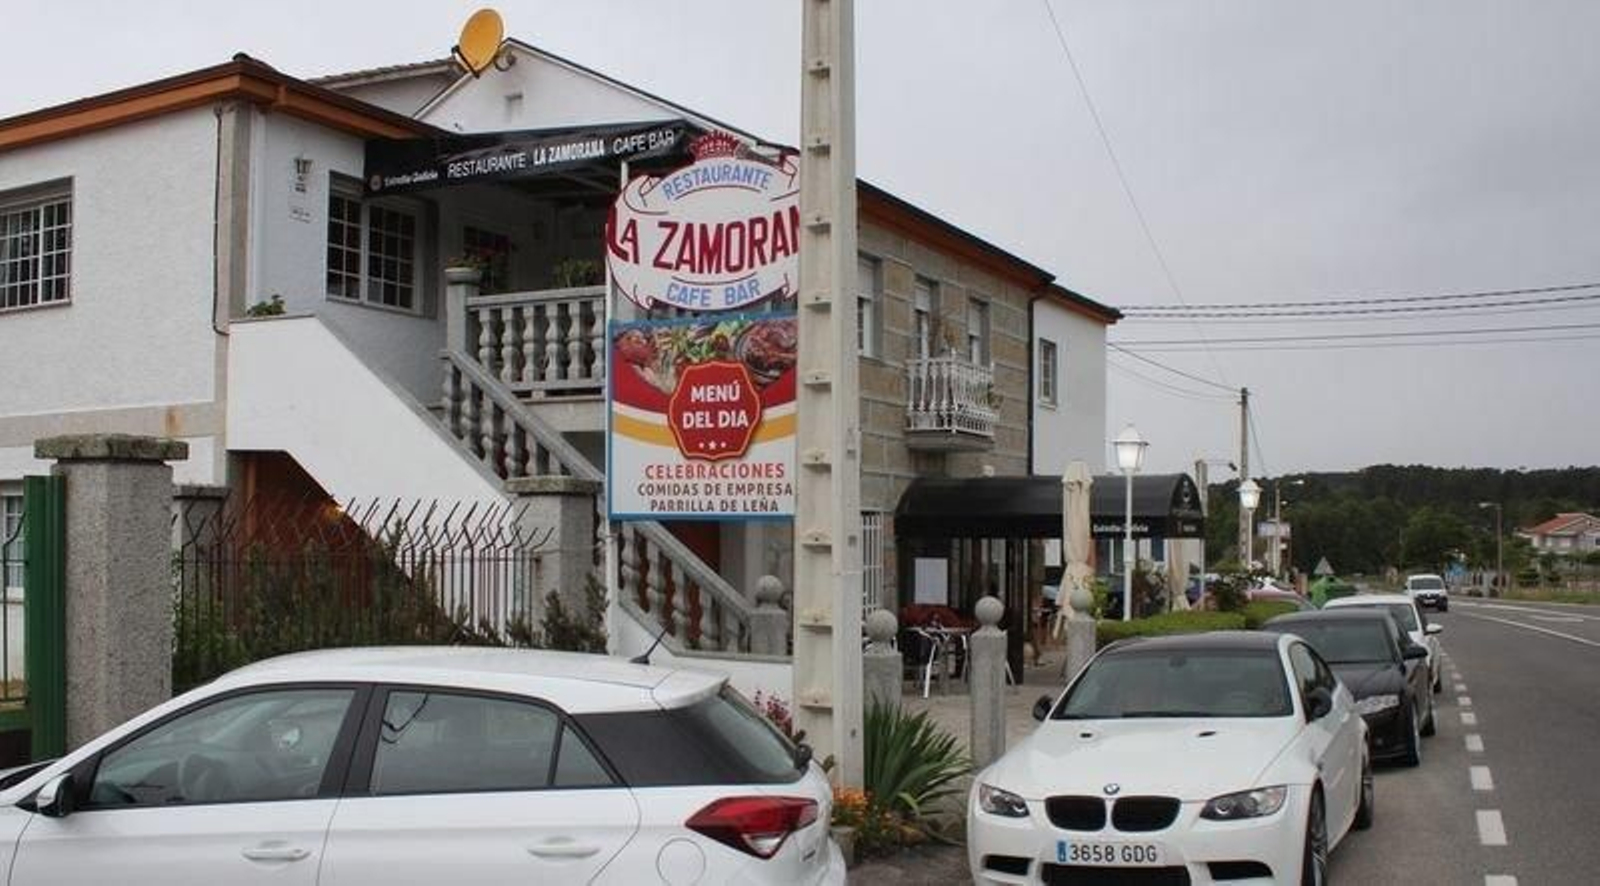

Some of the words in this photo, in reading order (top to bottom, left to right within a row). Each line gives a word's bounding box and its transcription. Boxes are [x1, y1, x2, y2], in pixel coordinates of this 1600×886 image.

[533, 148, 546, 166] LA
[549, 139, 605, 162] ZAMORANA
[613, 134, 646, 154] CAFE
[649, 130, 675, 149] BAR
[447, 152, 526, 177] RESTAURANTE
[662, 163, 773, 199] RESTAURANTE
[606, 206, 640, 264] LA
[653, 205, 799, 275] ZAMORAN
[667, 282, 712, 308] CAFE
[725, 279, 760, 306] BAR
[691, 380, 741, 403] MENÚ
[683, 411, 714, 430] DEL
[718, 409, 749, 428] DIA
[645, 463, 785, 480] CELEBRACIONES
[637, 483, 699, 497] COMIDAS
[704, 483, 722, 496] DE
[727, 482, 793, 496] EMPRESA
[651, 500, 714, 513] PARRILLA
[719, 500, 737, 513] DE
[742, 496, 779, 513] LEÑA
[1070, 844, 1115, 862] 3658
[1121, 845, 1157, 863] GDG
